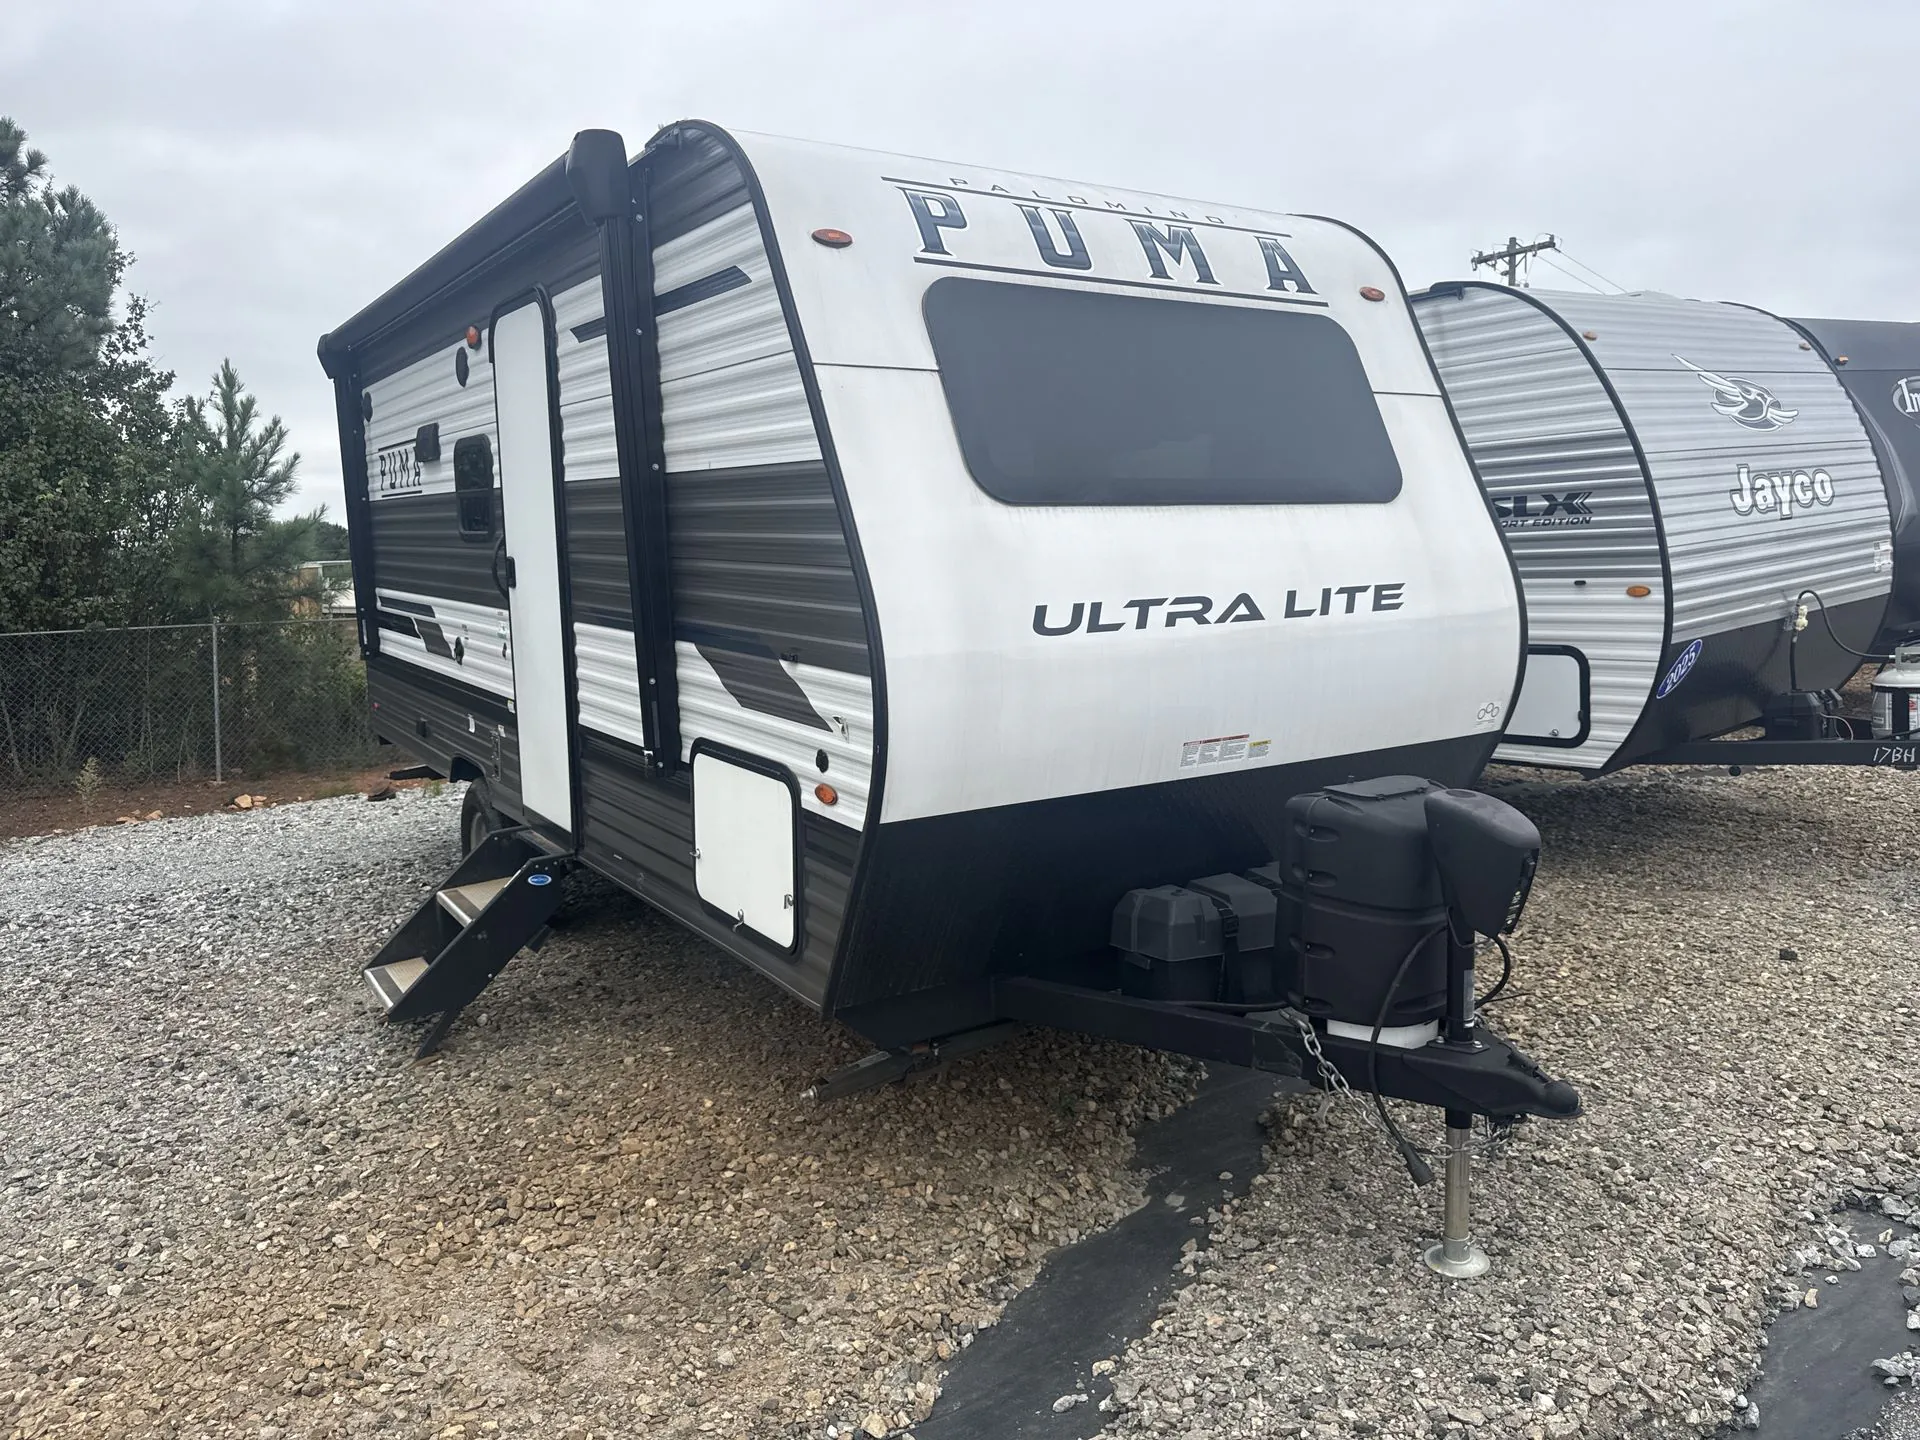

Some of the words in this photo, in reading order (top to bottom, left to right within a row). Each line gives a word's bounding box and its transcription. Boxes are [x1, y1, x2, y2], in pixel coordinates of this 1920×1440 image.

[949, 177, 1225, 224] PALOMINO
[896, 185, 1320, 296] PUMA
[379, 447, 421, 491] PUMA
[1730, 463, 1835, 520] Jayco
[1491, 491, 1593, 518] SLX
[1532, 516, 1592, 527] EDITION
[1032, 592, 1266, 637] ULTRA
[1284, 582, 1406, 619] LITE
[1664, 644, 1696, 693] 2025
[1873, 746, 1916, 763] 17BH
